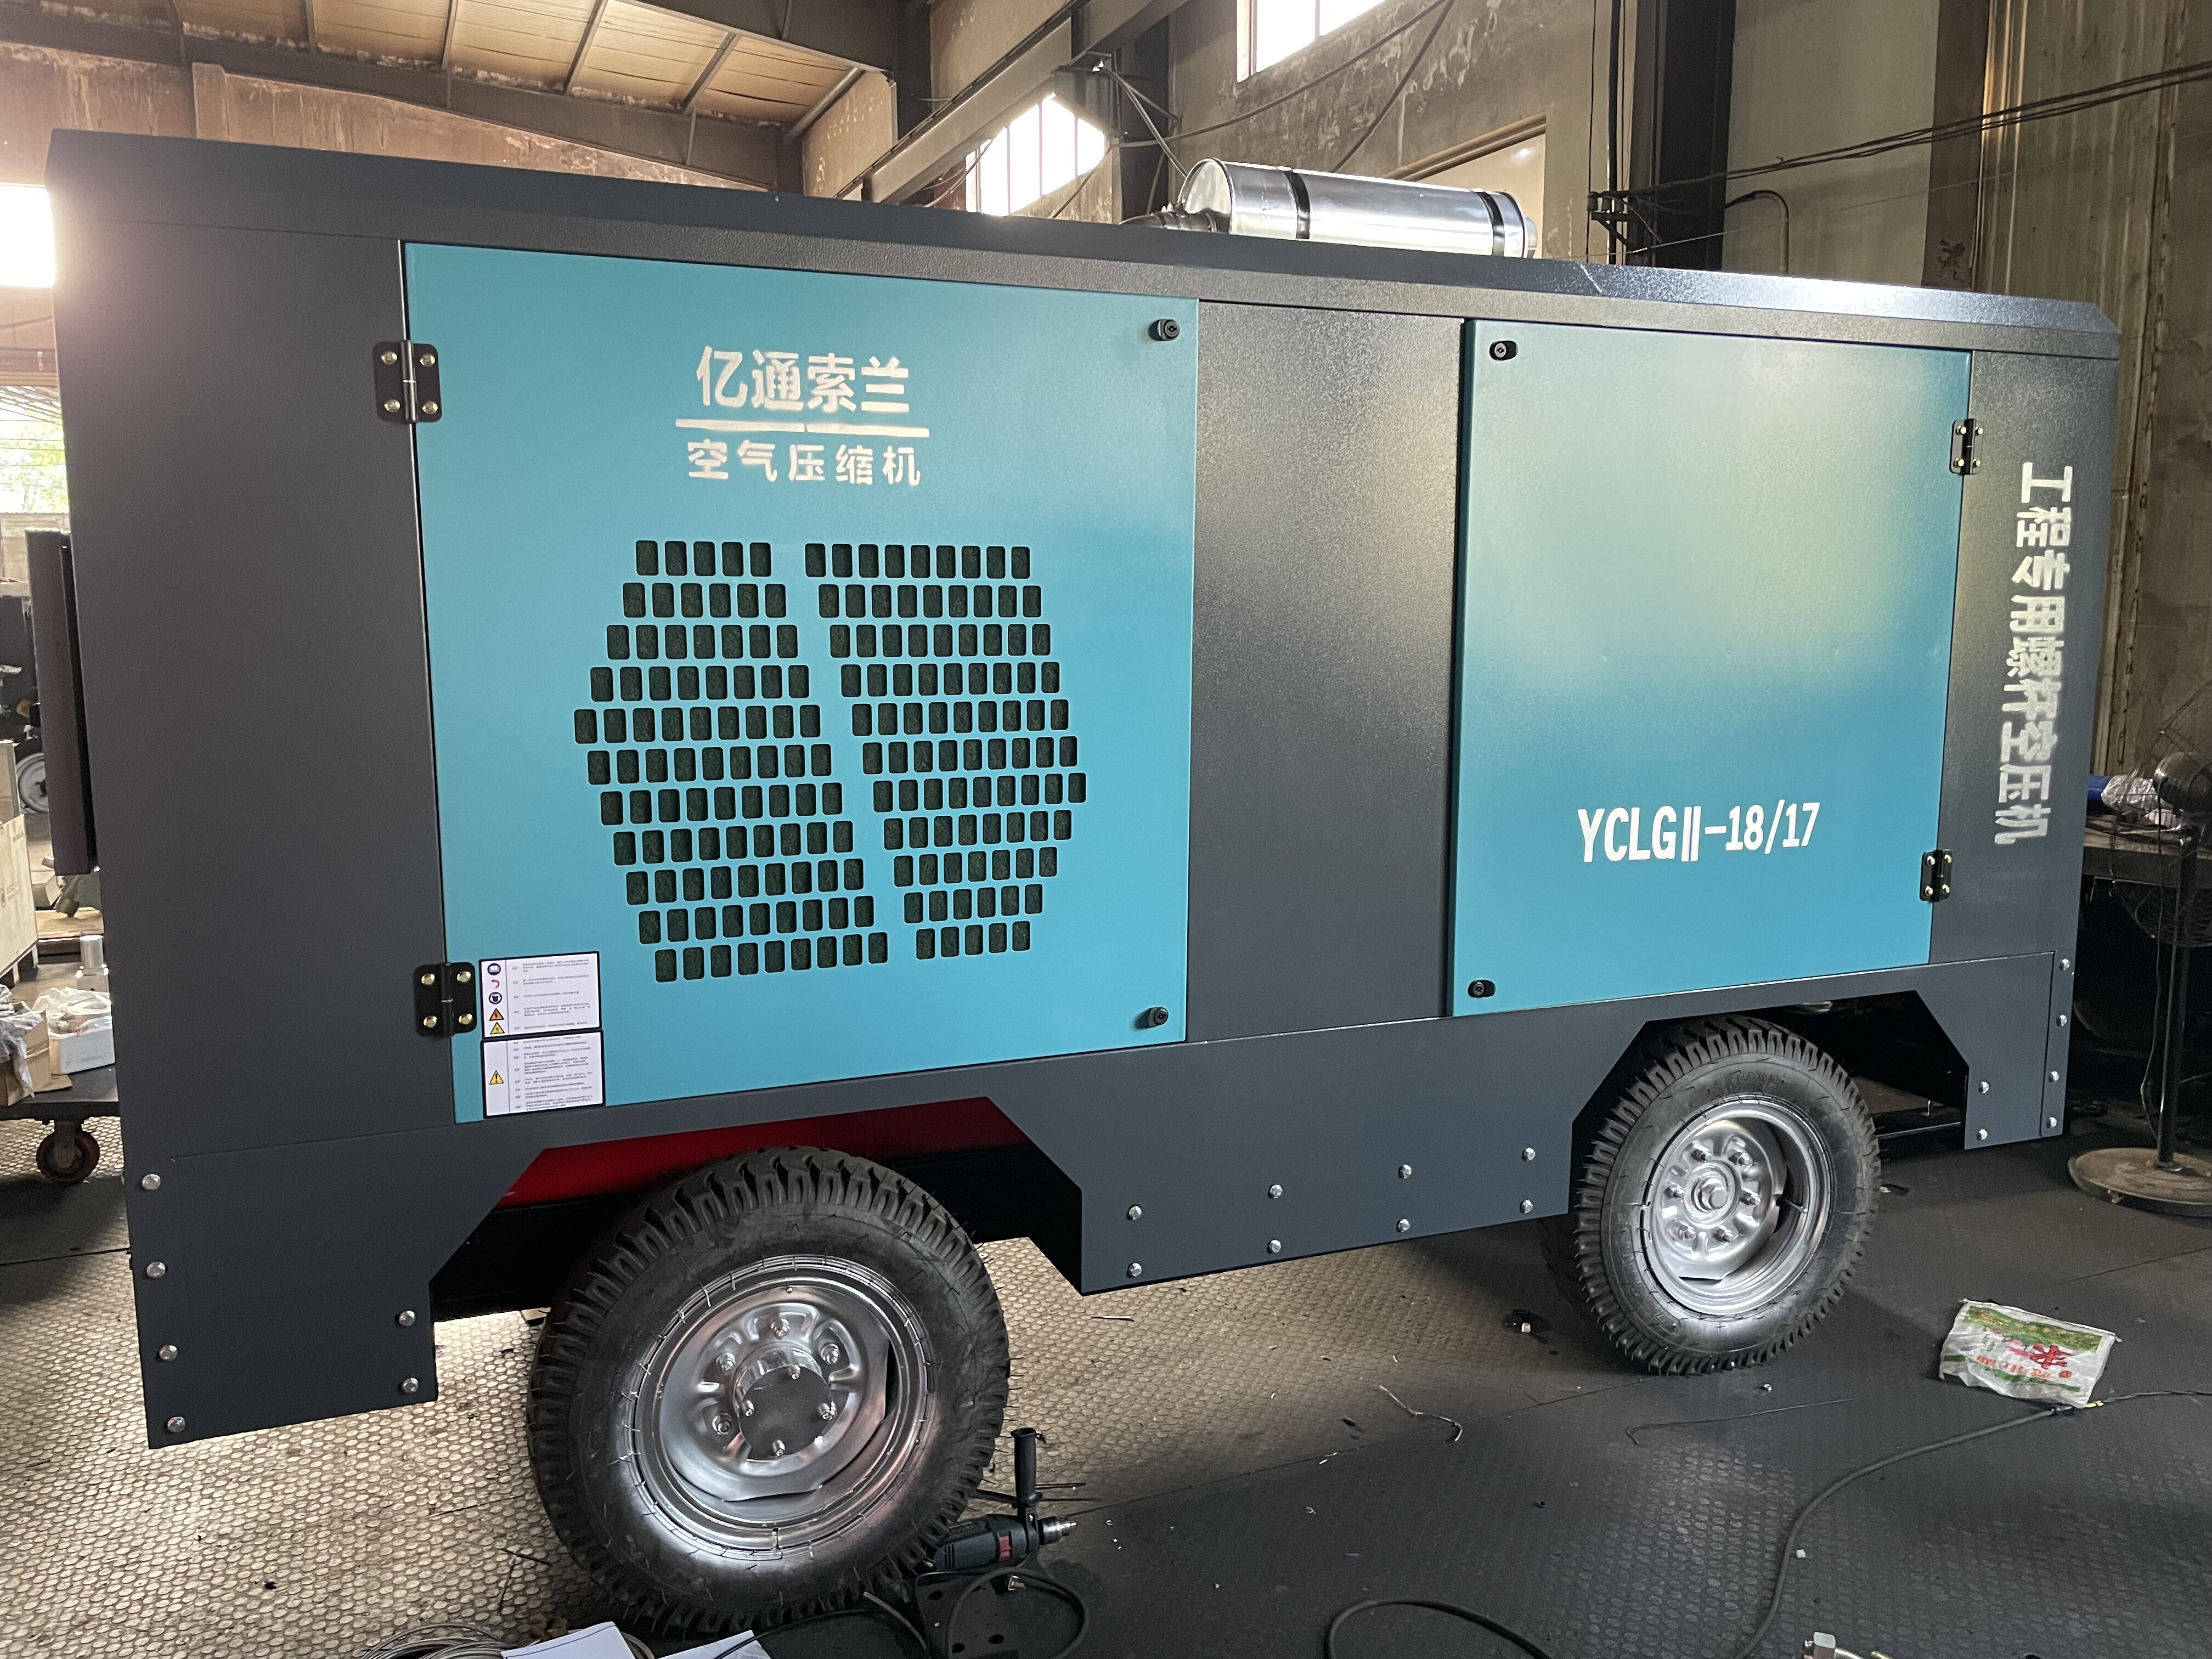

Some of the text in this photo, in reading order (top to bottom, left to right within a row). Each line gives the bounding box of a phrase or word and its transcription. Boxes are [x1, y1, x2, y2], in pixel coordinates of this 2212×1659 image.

[696, 346, 909, 413] 亿通索兰
[687, 438, 921, 486] 空气压缩机
[1994, 462, 2073, 845] 工程专用螺杆空压机
